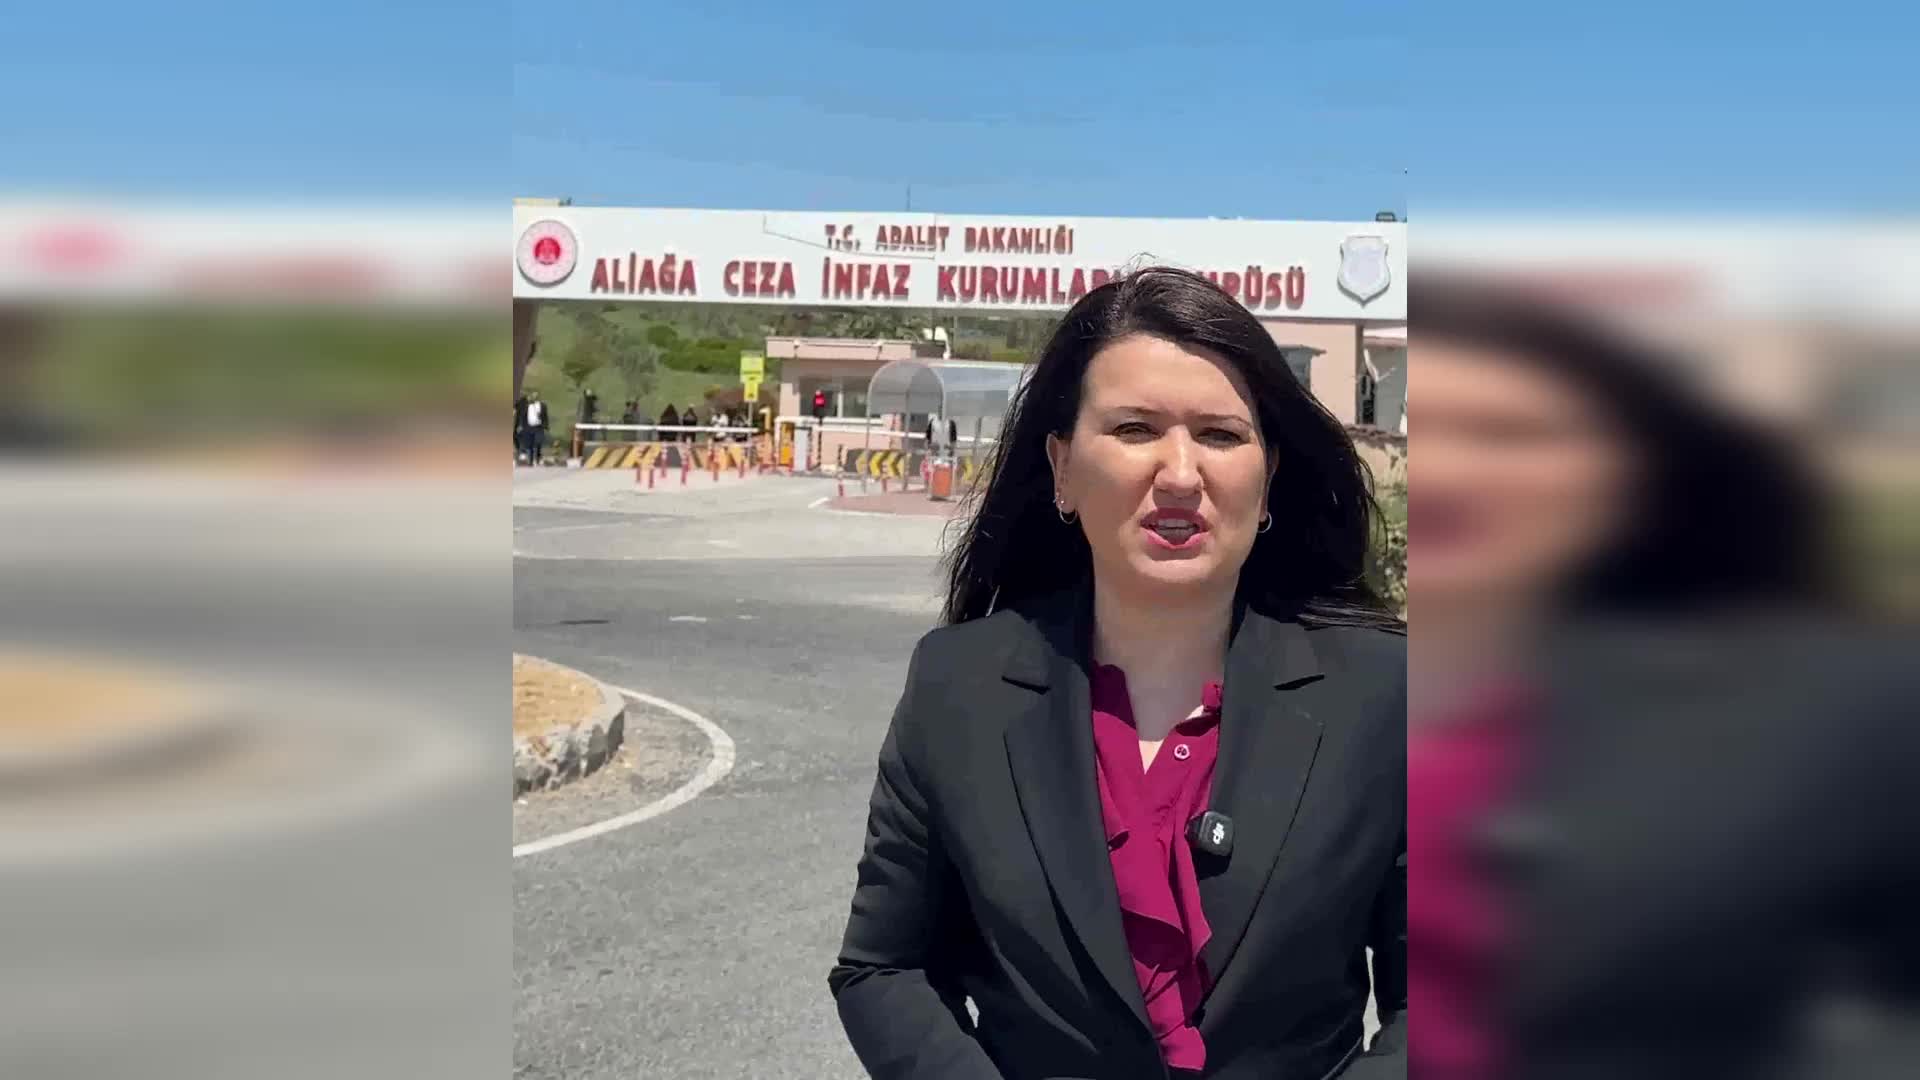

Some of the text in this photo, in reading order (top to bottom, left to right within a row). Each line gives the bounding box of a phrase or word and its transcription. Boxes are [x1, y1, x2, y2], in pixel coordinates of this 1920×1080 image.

[825, 224, 1073, 254] T.C. ADALET BAKANLIĞI
[590, 252, 697, 296] ALİAĞA
[723, 260, 796, 298] CEZA
[822, 256, 911, 300] İNFAZ
